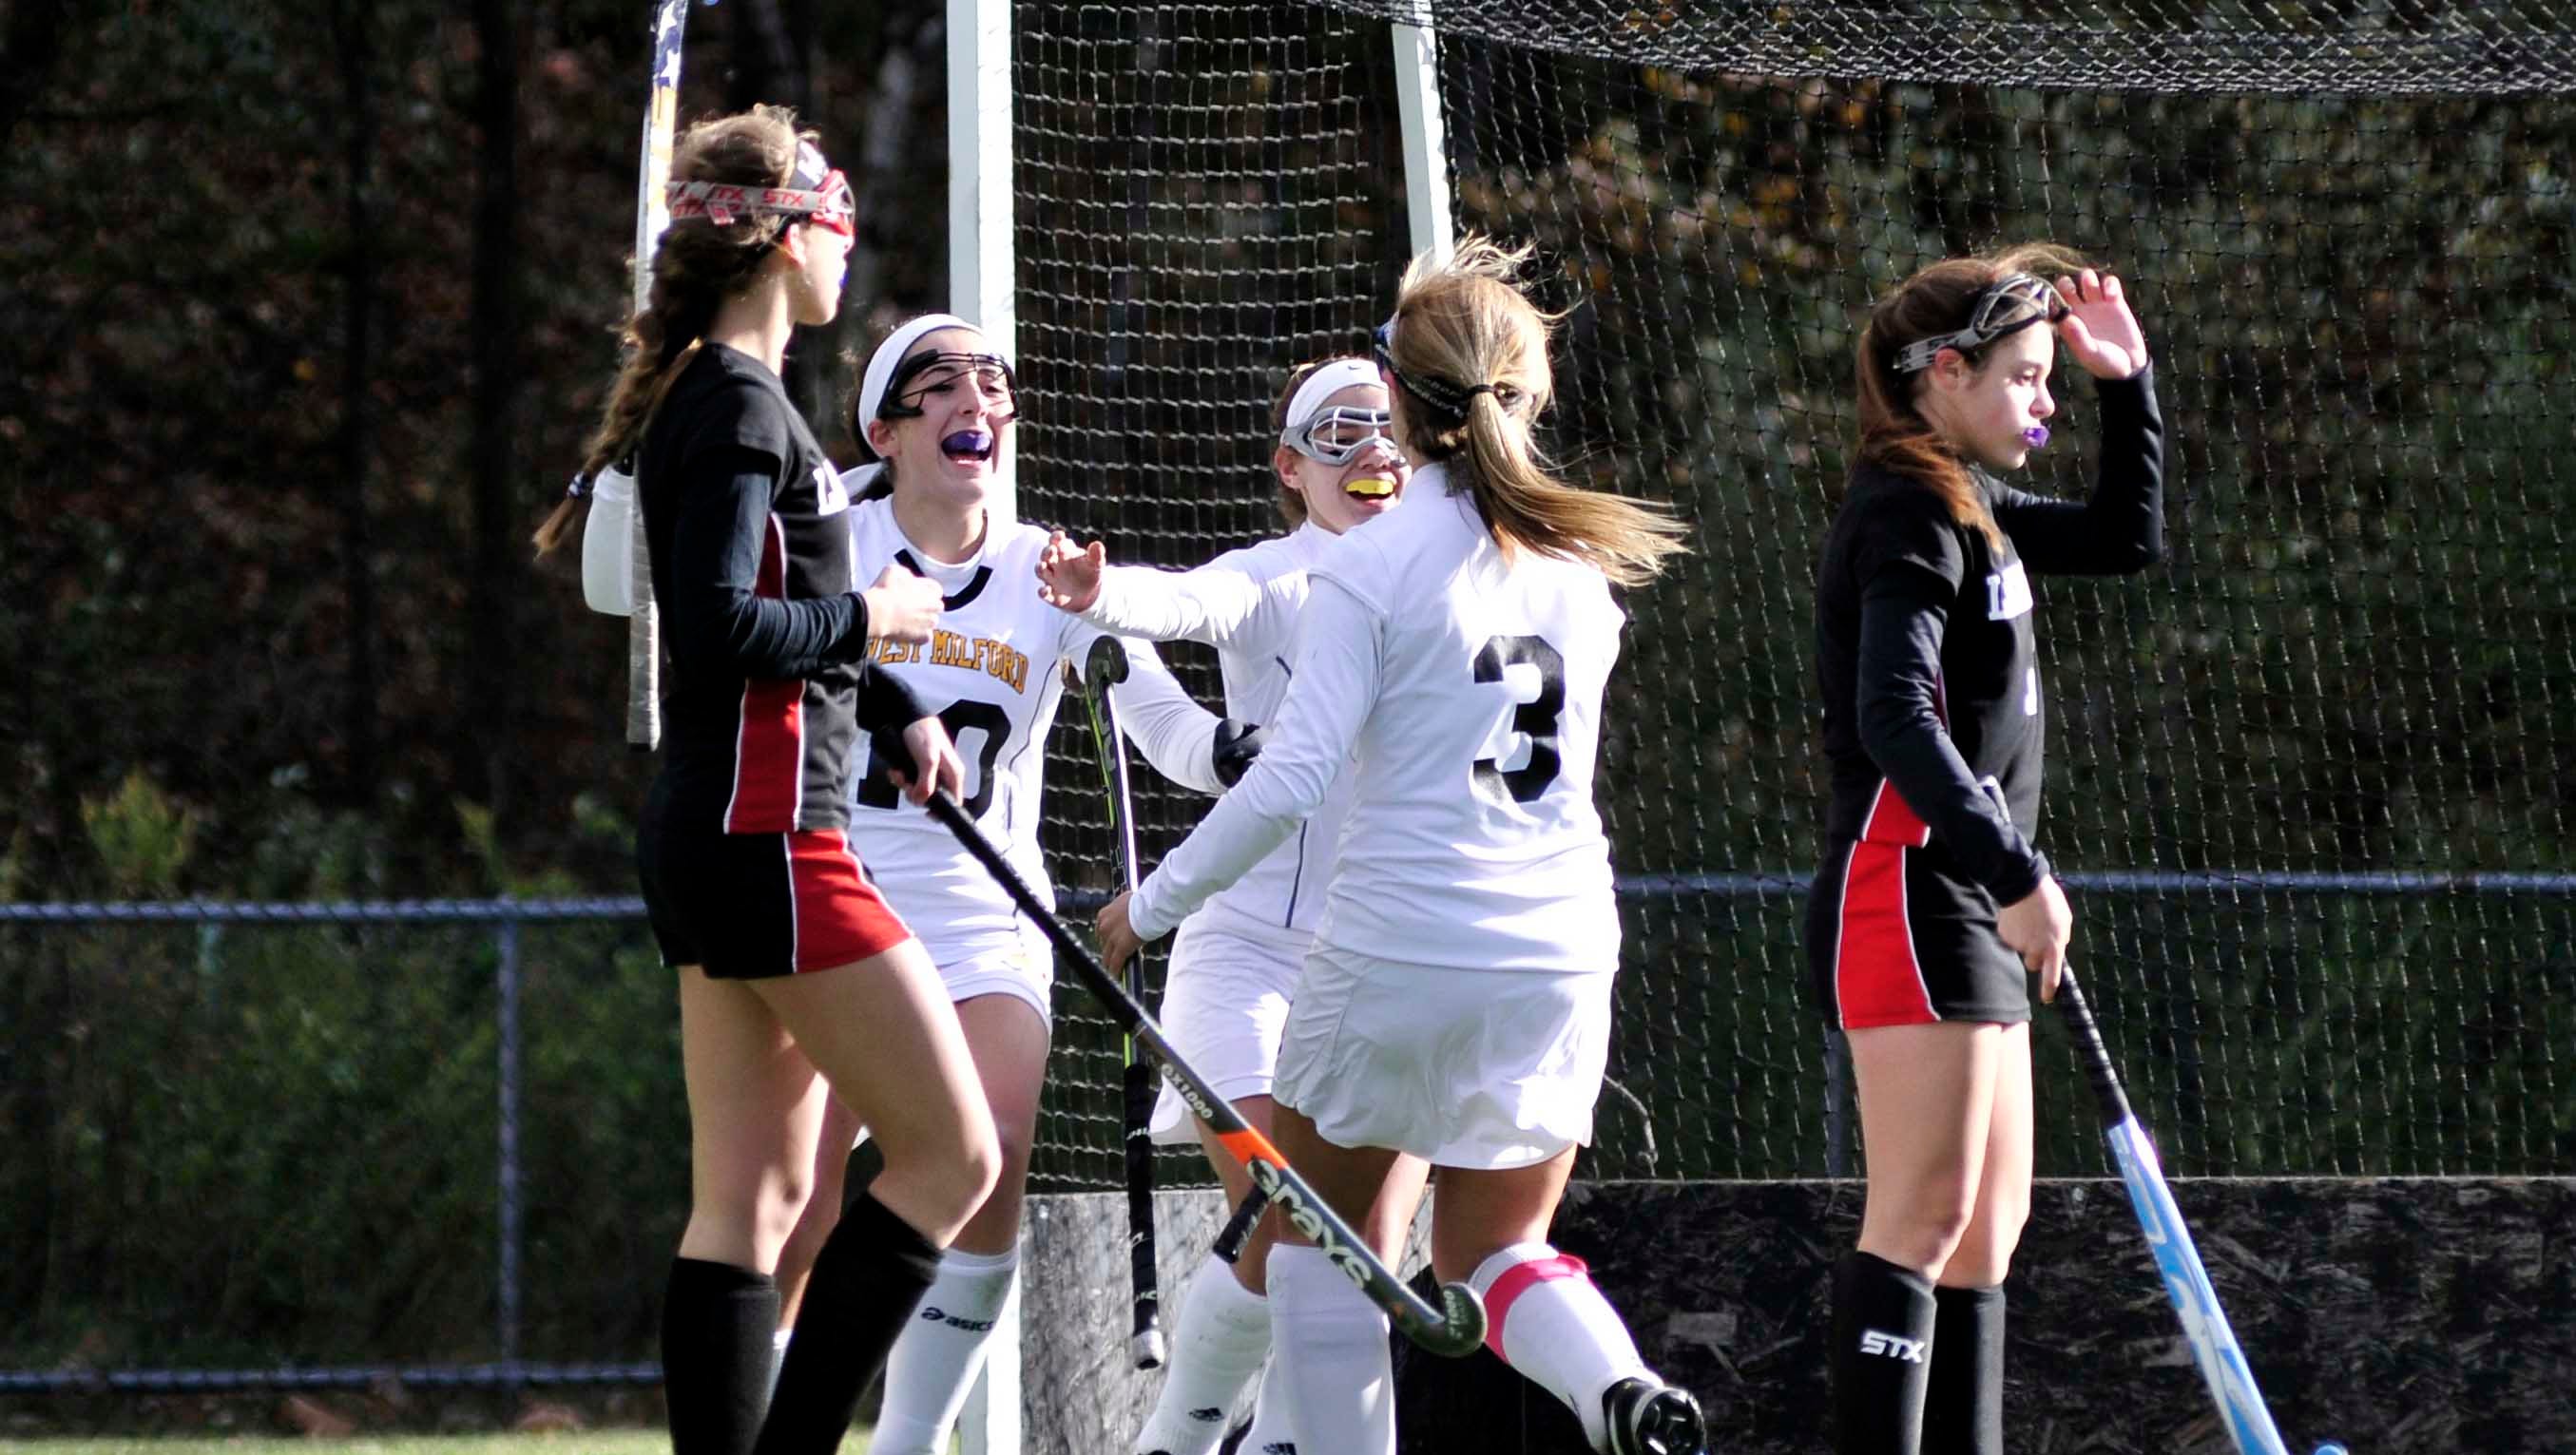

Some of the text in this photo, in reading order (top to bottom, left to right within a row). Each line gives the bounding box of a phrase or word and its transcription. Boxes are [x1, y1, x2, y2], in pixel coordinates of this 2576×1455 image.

[762, 190, 805, 206] STX
[930, 629, 1028, 695] MILFORD
[1473, 635, 1566, 803] 3
[1860, 1331, 1925, 1364] STX
